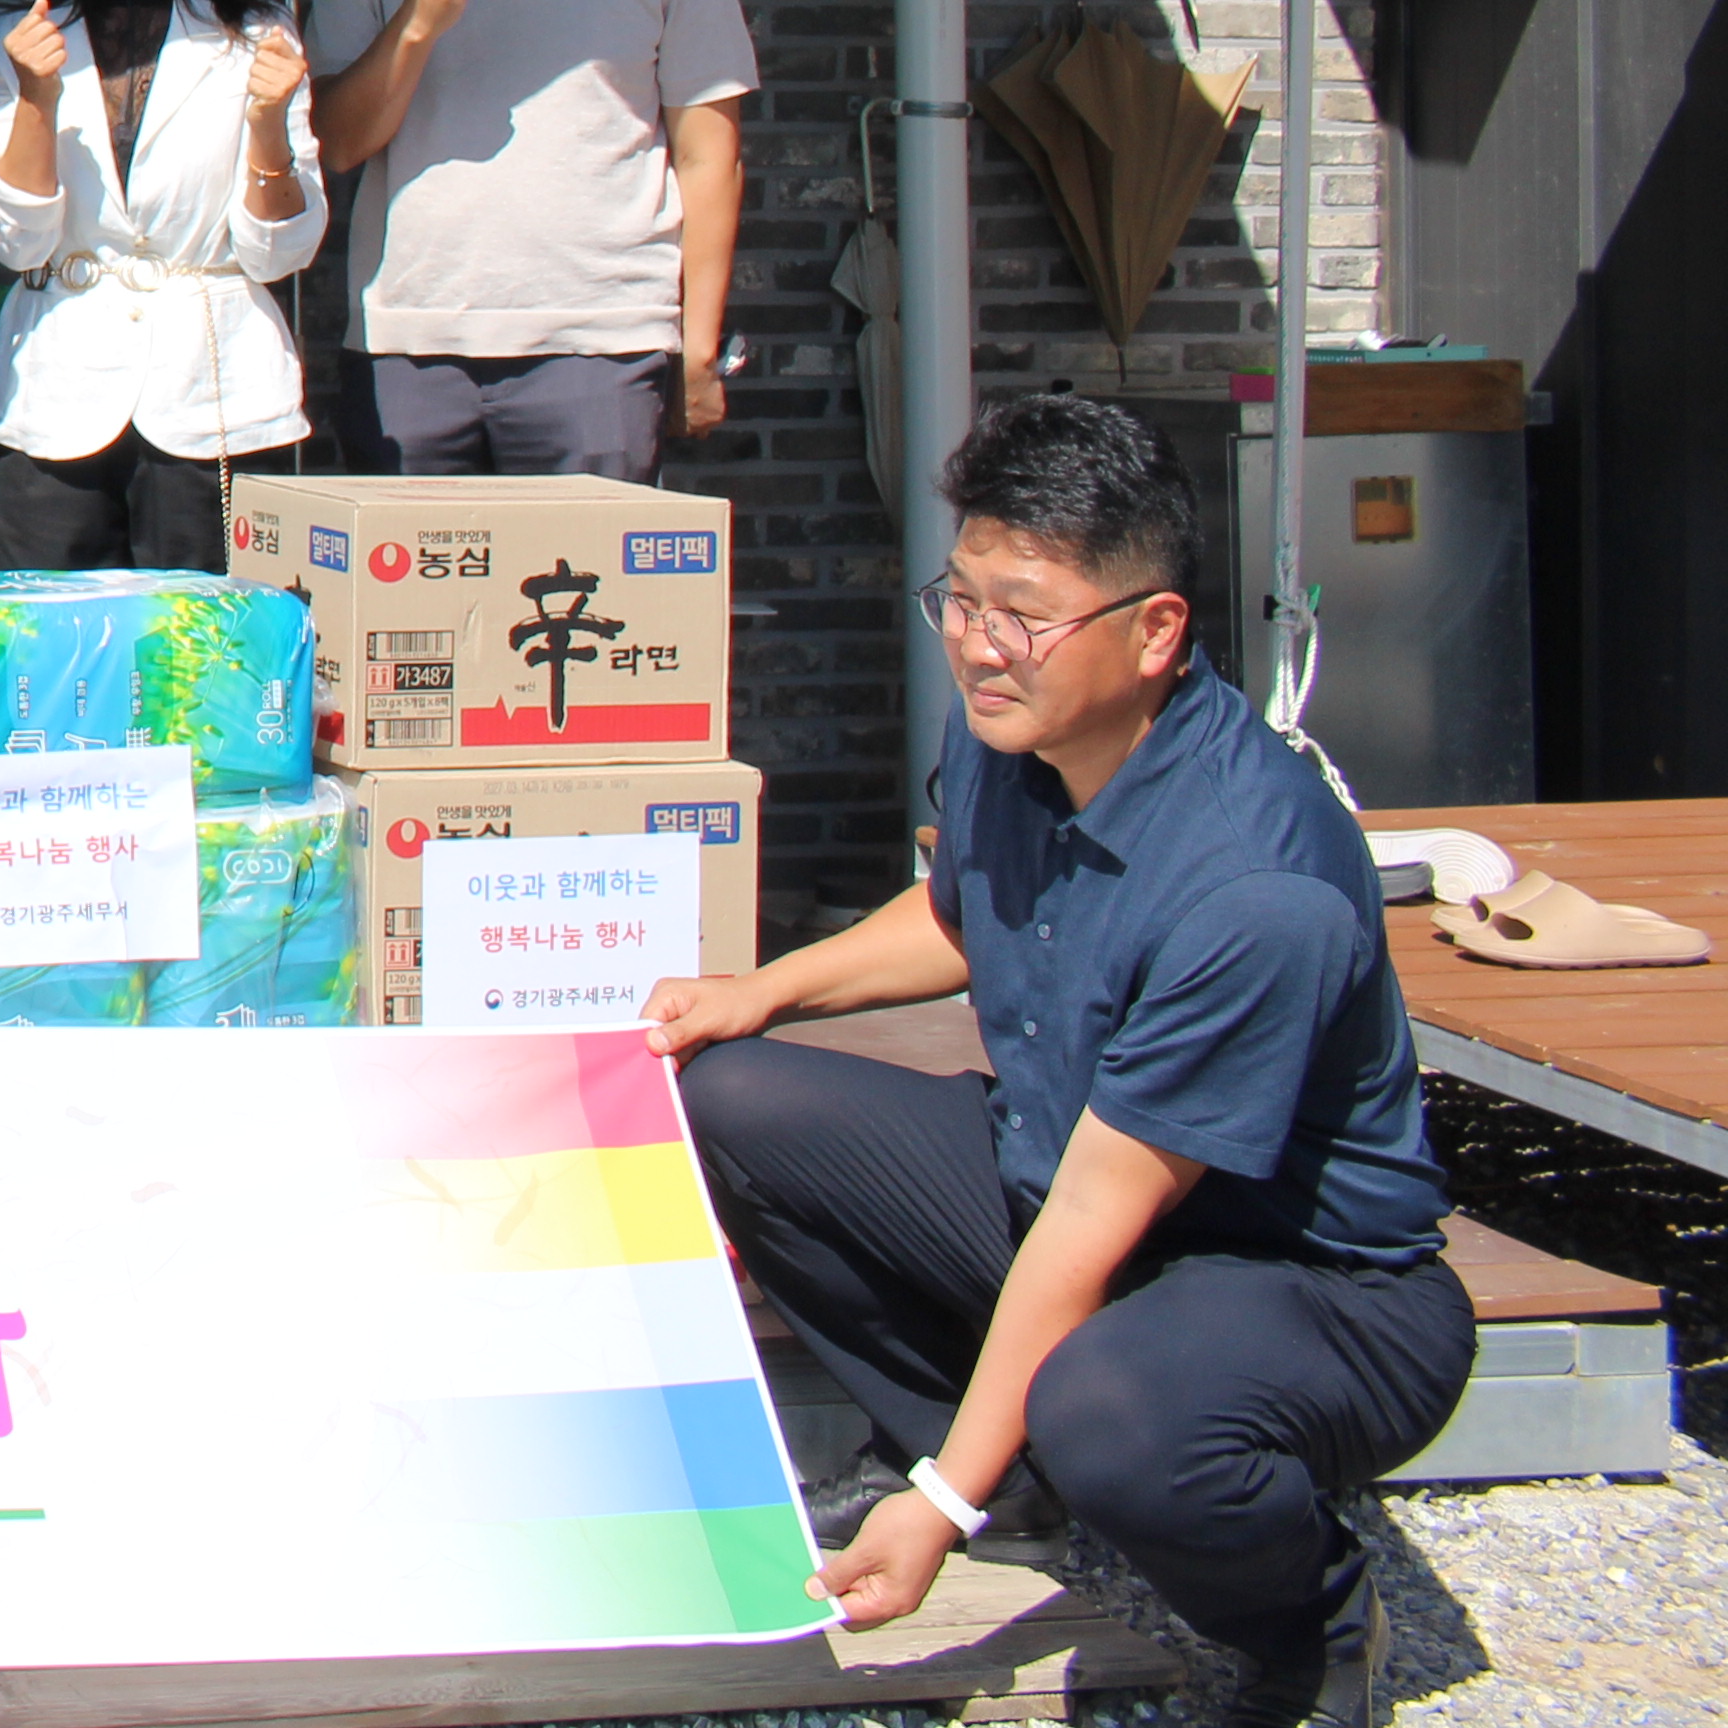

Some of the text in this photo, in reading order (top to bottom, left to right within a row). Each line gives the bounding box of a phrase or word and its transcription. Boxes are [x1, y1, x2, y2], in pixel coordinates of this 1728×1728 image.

[251, 524, 280, 556] 농심
[312, 530, 347, 568] 멀티팩
[417, 529, 492, 544] 인생을 맛있게
[629, 536, 709, 569] 멀티팩
[416, 546, 492, 580] 농심
[508, 557, 626, 731] 辛
[608, 644, 680, 676] 라면
[396, 665, 452, 688] 가3487
[256, 709, 285, 745] 30
[39, 781, 149, 813] 함께하는
[436, 804, 512, 820] 인생을 맛있게
[85, 833, 139, 864] 행사
[467, 869, 659, 902] 이웃과 함께하는
[0, 900, 129, 927] 경기광주세무서
[479, 919, 647, 954] 행복나눔 행사
[387, 973, 407, 985] 120
[511, 984, 636, 1009] 경기광주세무서
